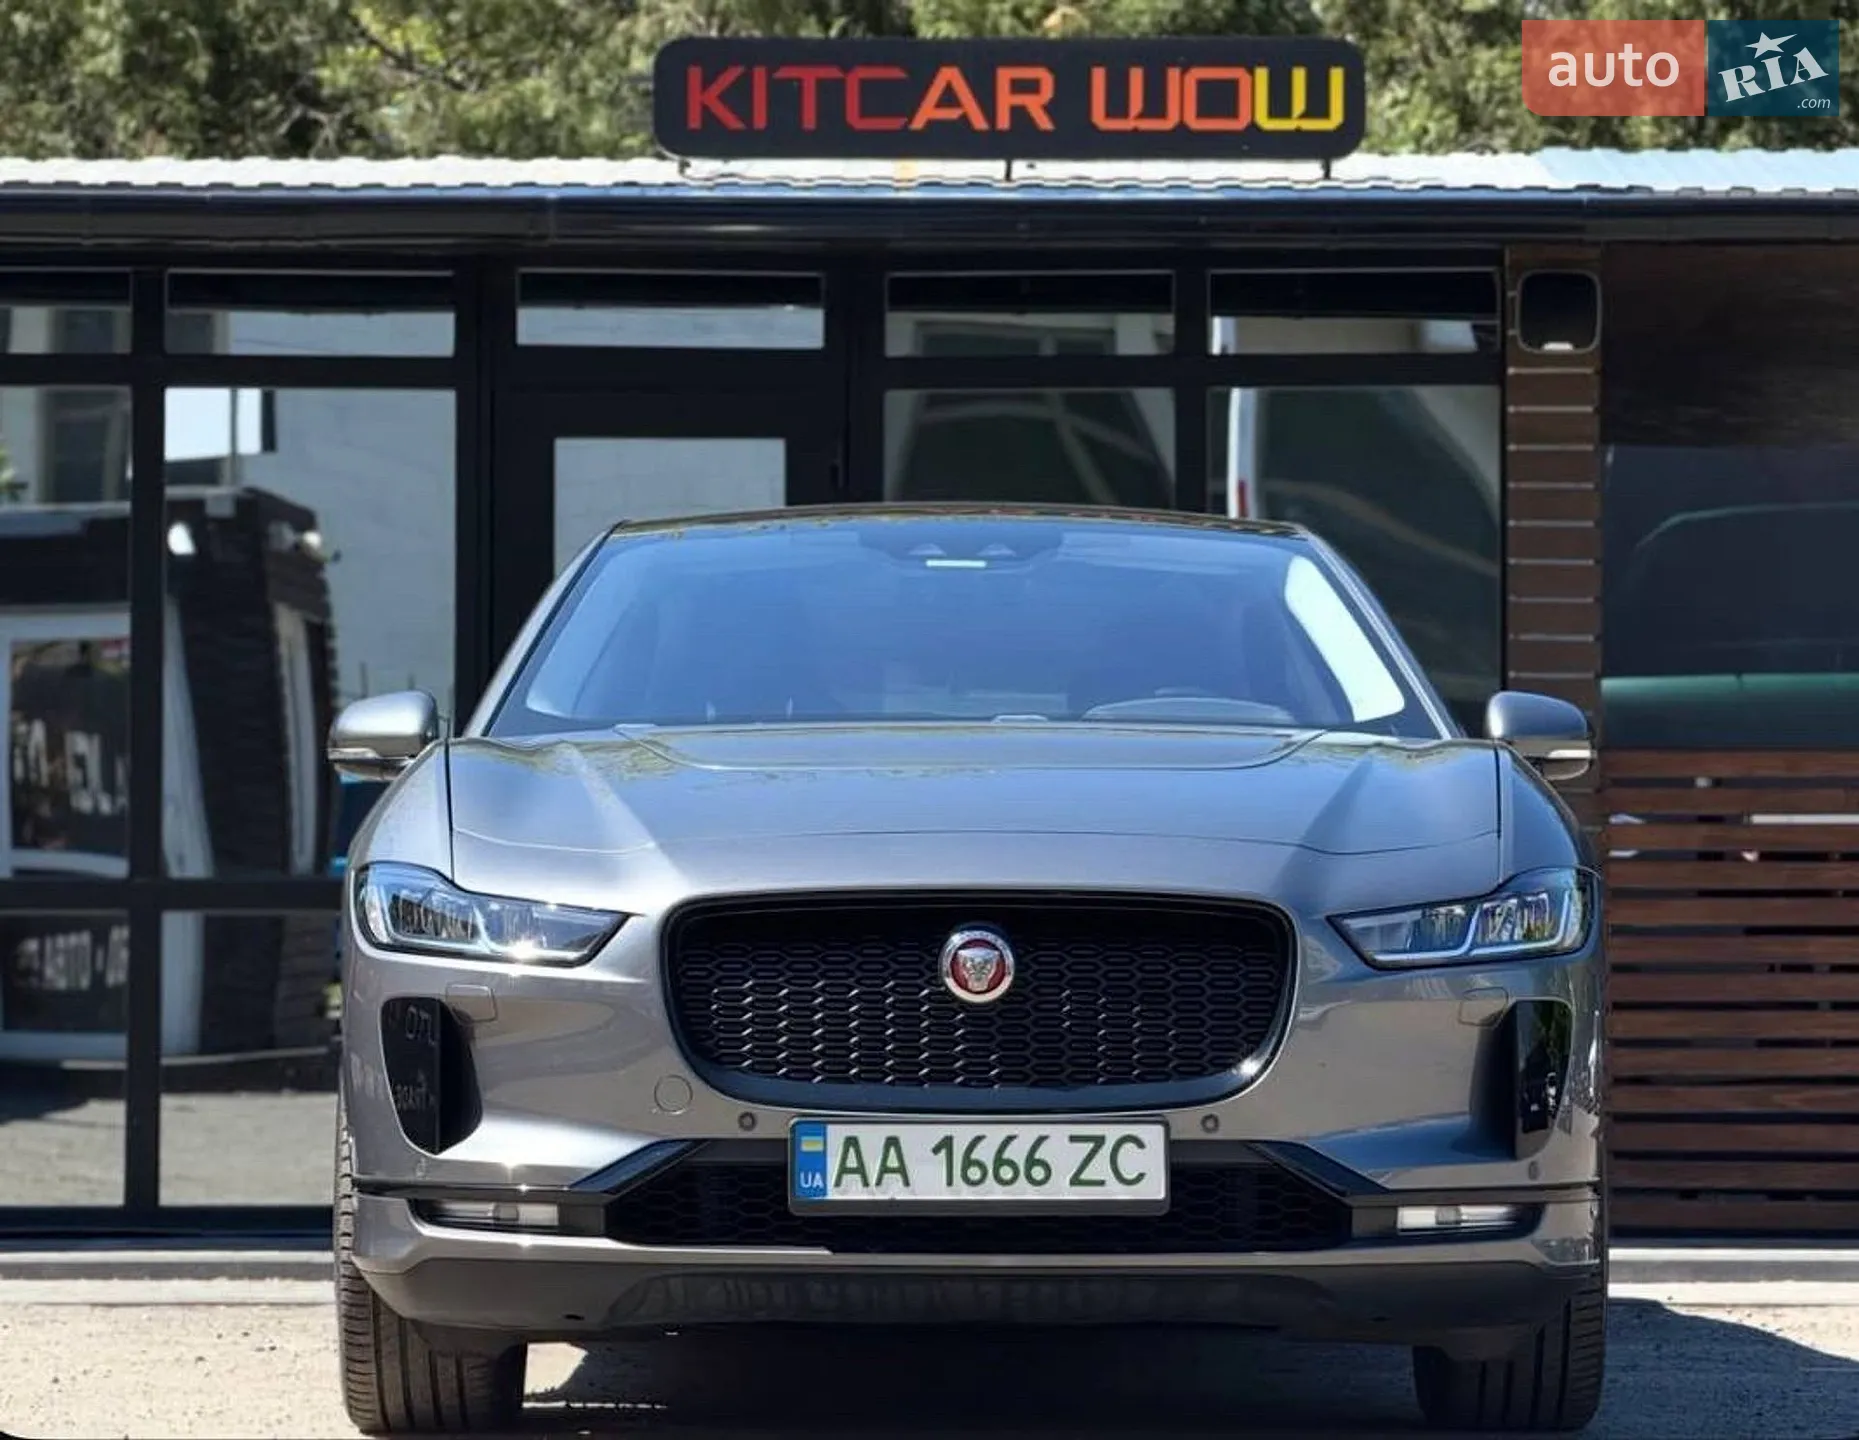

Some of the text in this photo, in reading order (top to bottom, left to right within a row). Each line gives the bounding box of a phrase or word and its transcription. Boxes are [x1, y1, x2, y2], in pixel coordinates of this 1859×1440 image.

[687, 66, 1344, 131] KITCAR WOW
[799, 1173, 824, 1189] UA
[833, 1134, 1147, 1188] AA 1666 ZC
